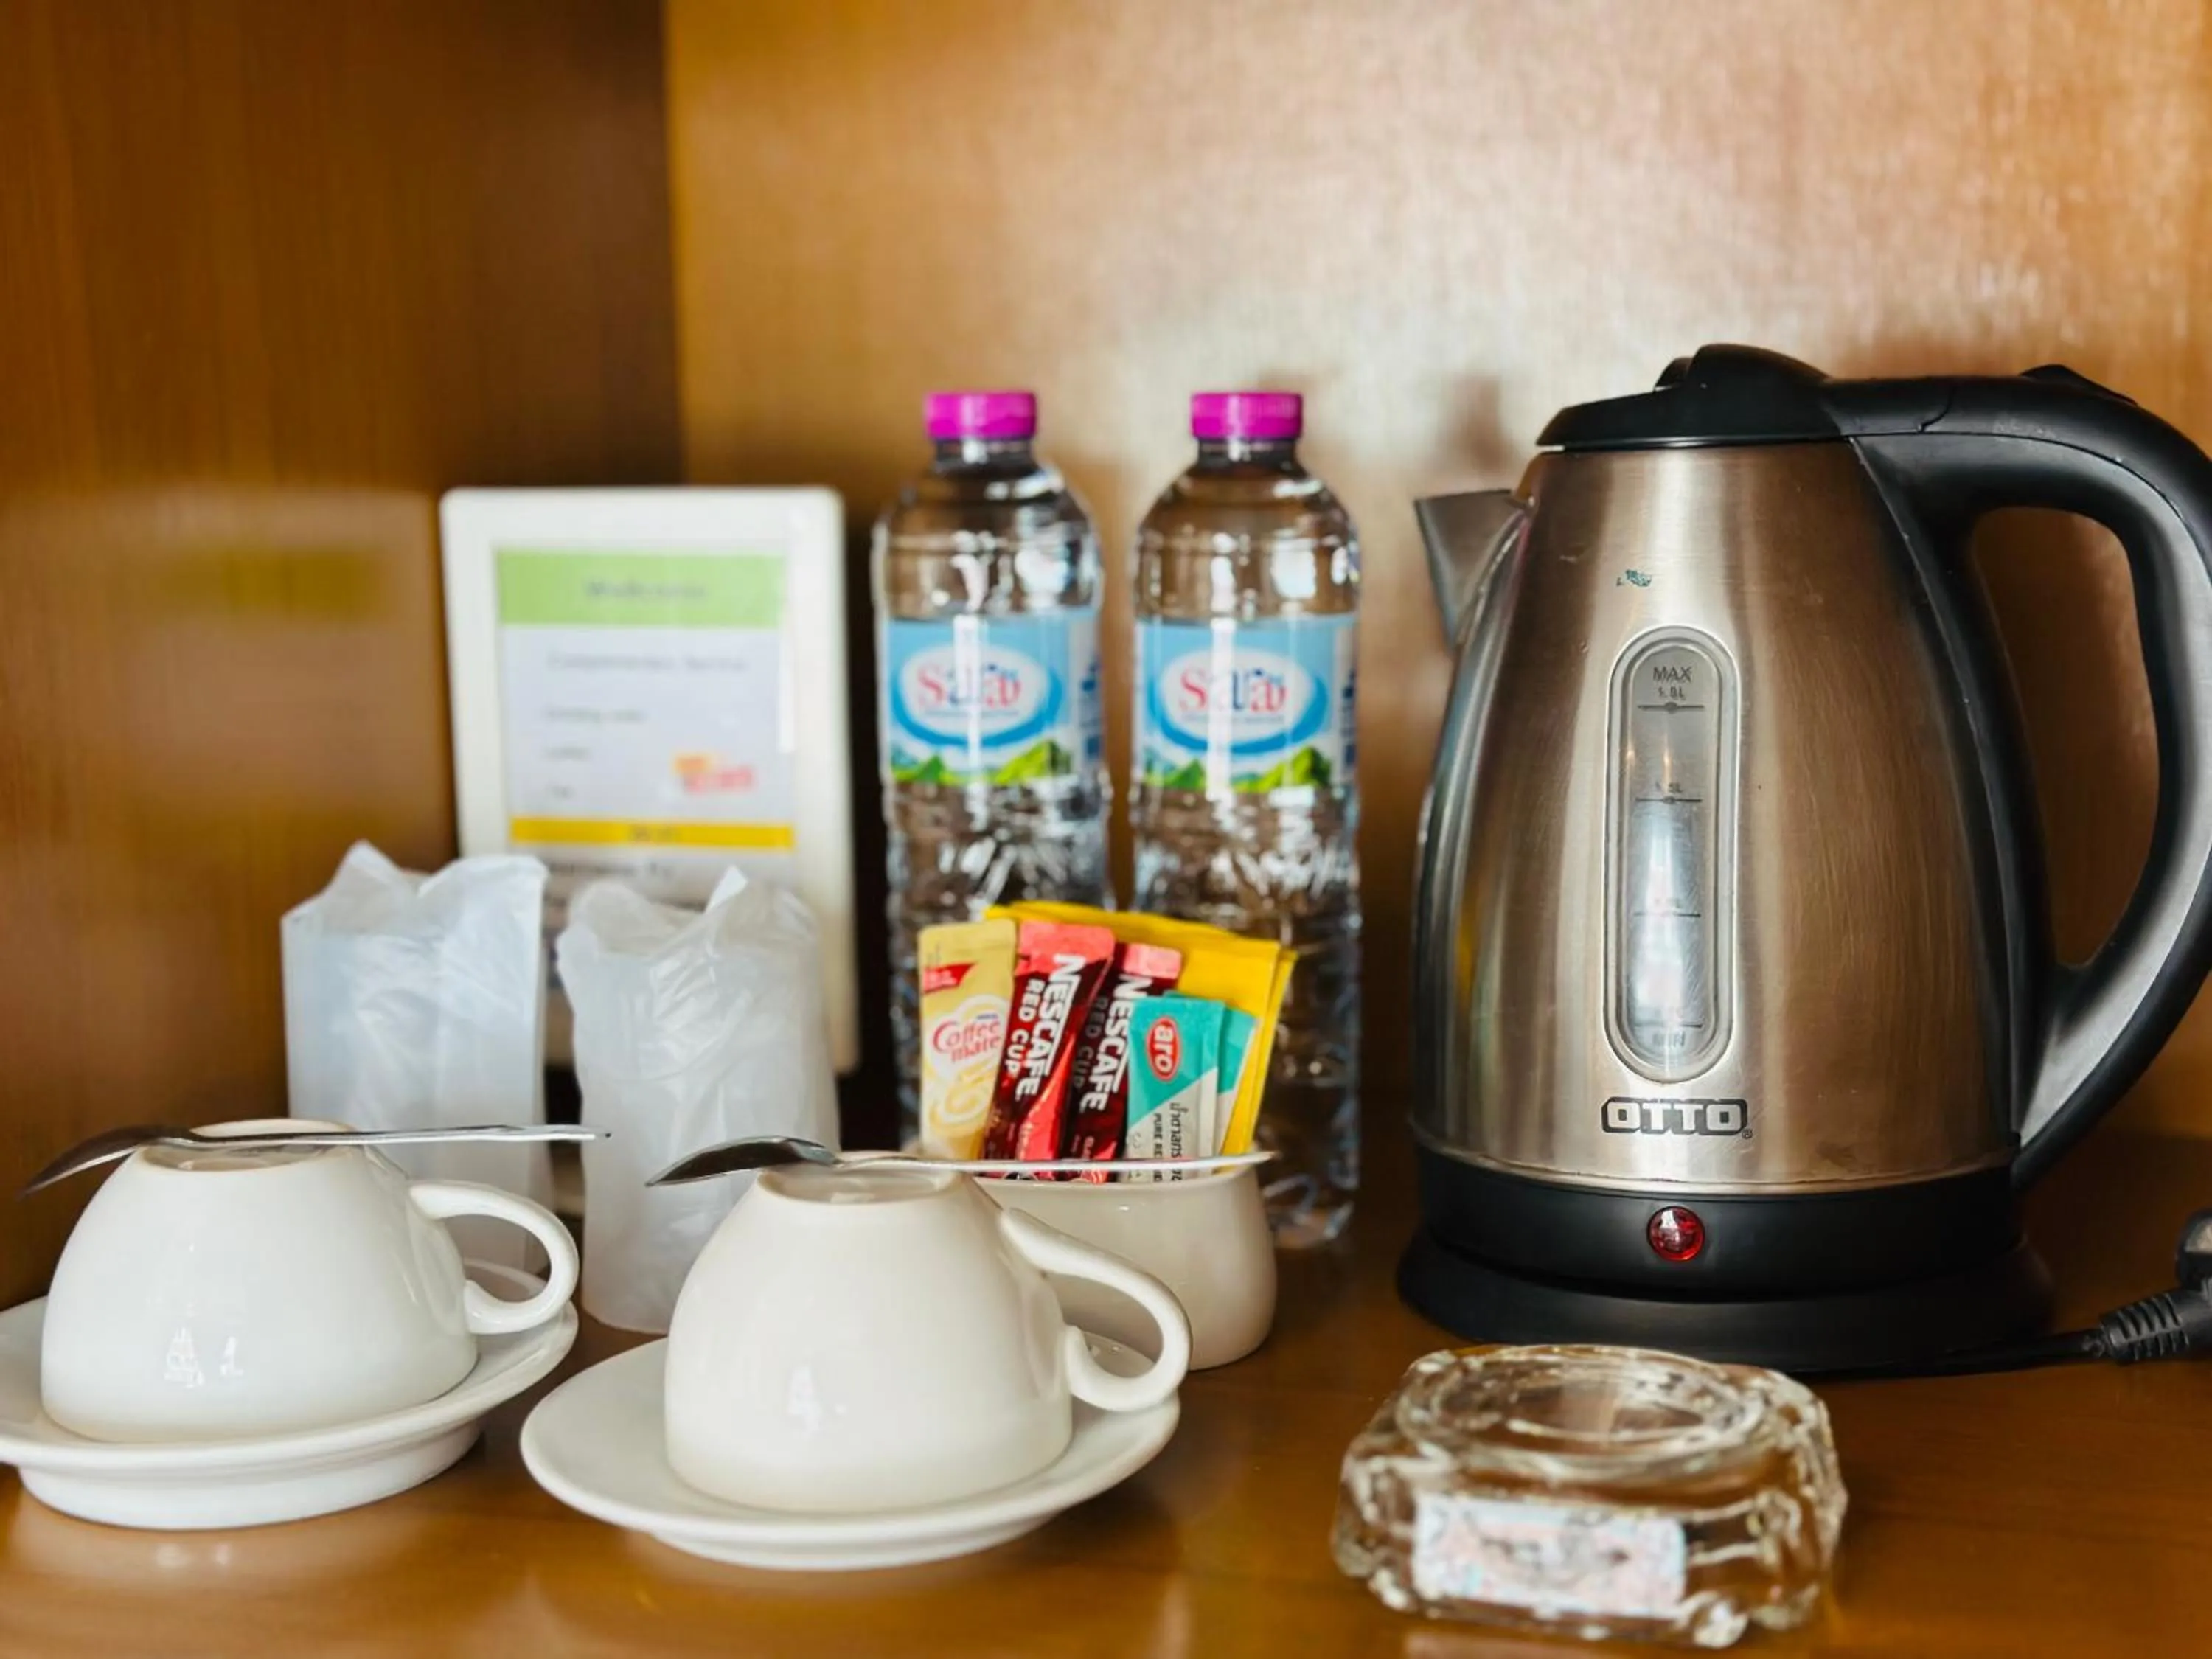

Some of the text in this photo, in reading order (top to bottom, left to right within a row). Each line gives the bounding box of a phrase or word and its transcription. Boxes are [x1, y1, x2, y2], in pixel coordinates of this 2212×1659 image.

[1652, 666, 1692, 683] MAX
[933, 1020, 1001, 1053] Coffee
[1005, 978, 1046, 1078] RED CUP
[1074, 997, 1108, 1089] RED CUP
[951, 1035, 1001, 1063] mate
[1154, 1025, 1175, 1073] aro
[1603, 1099, 1746, 1135] OTTO
